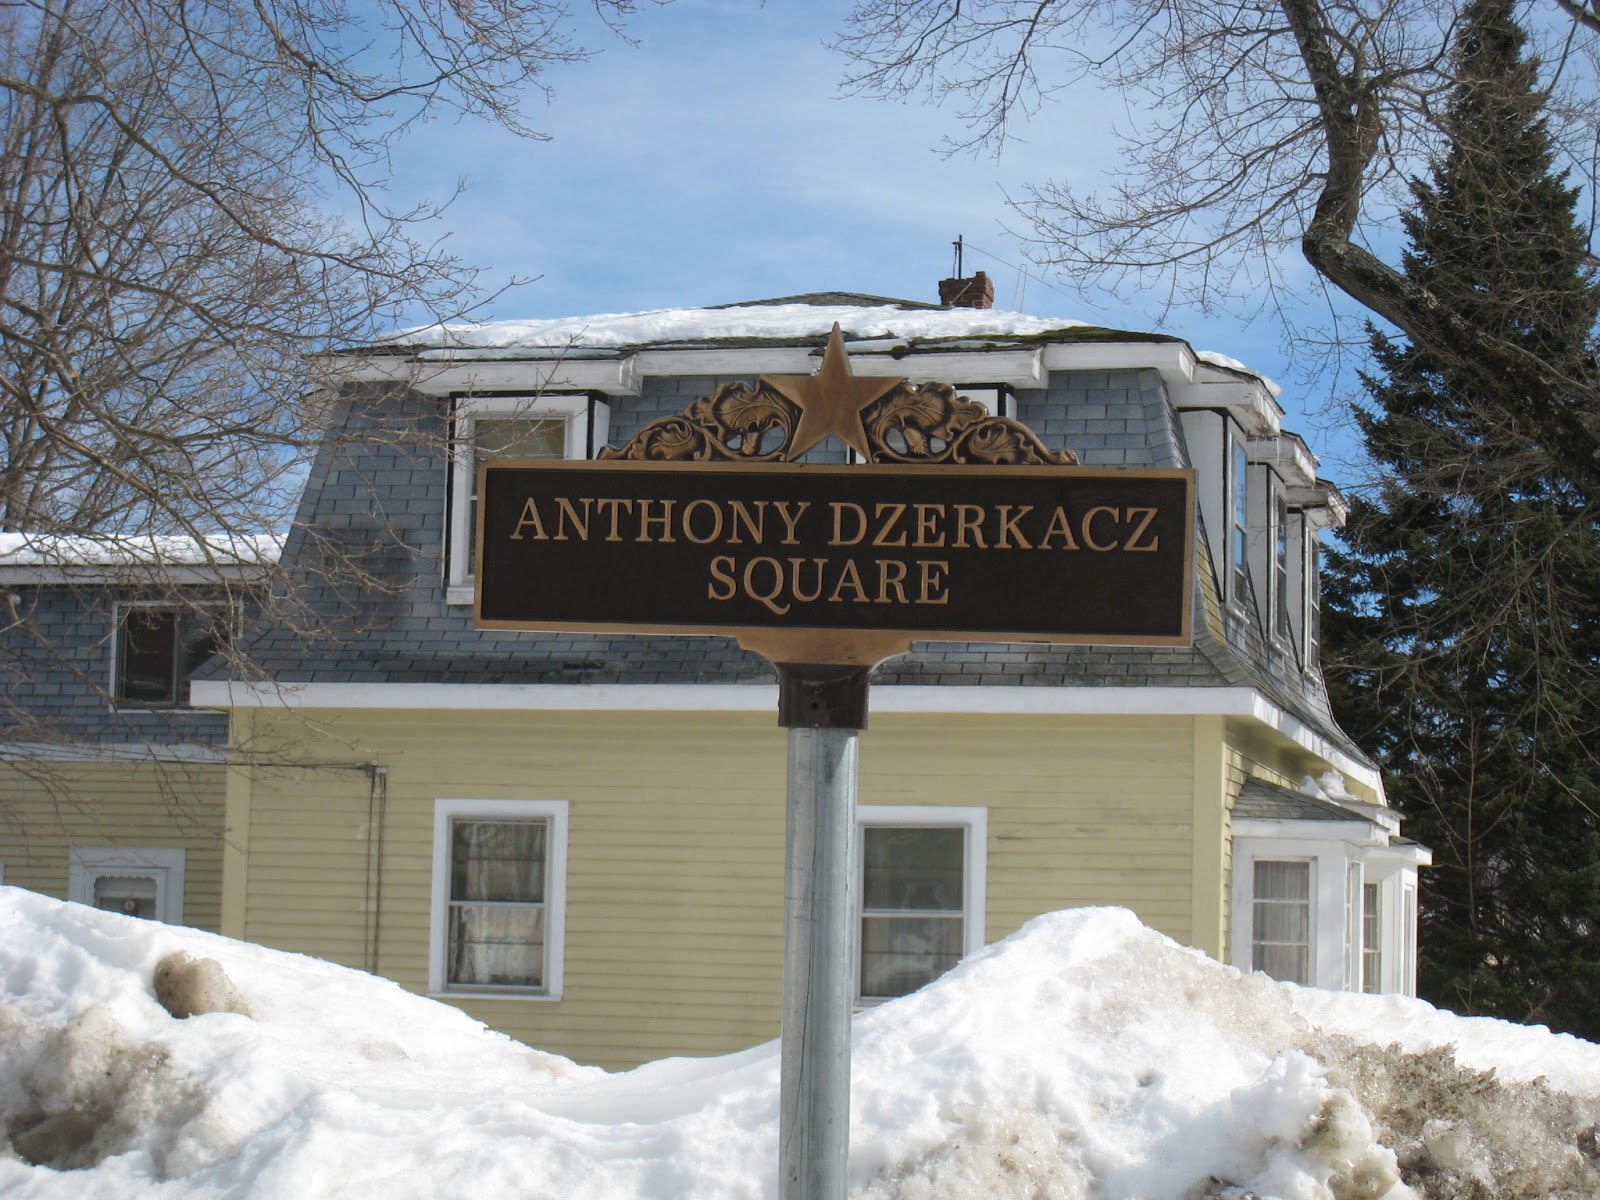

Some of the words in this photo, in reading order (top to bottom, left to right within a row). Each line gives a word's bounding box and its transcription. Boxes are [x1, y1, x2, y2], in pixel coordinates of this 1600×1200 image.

[509, 497, 811, 545] ANTHONY
[827, 502, 1160, 553] DZERKACZ
[708, 556, 950, 615] SQUARE
